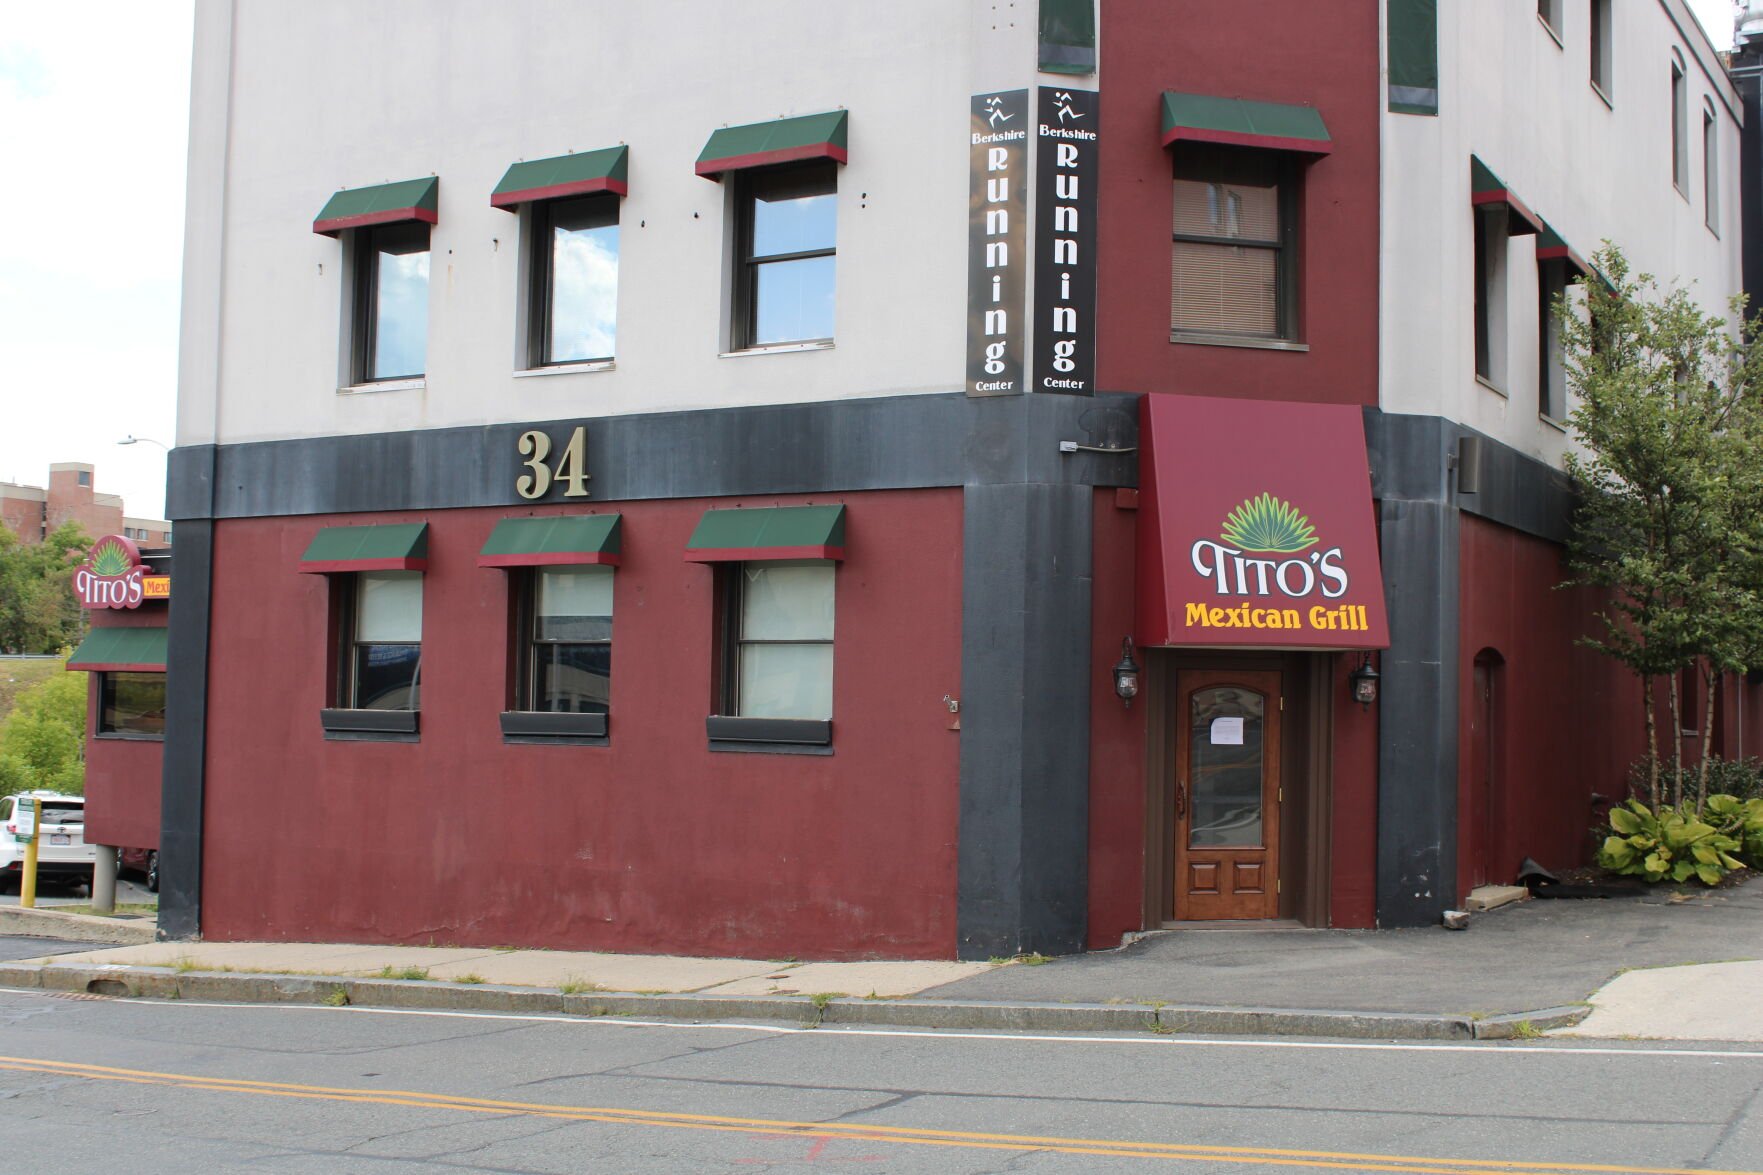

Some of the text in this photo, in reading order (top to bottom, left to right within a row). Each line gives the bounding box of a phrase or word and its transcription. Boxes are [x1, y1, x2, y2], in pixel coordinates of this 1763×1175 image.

[972, 130, 1025, 145] Berkshire
[1039, 125, 1096, 141] Berkshire
[985, 147, 1009, 374] Running
[1053, 143, 1079, 373] Running
[975, 380, 1013, 391] Center
[1043, 377, 1085, 389] Center
[516, 426, 592, 499] 34
[1185, 602, 1369, 630] Mexican Grill
